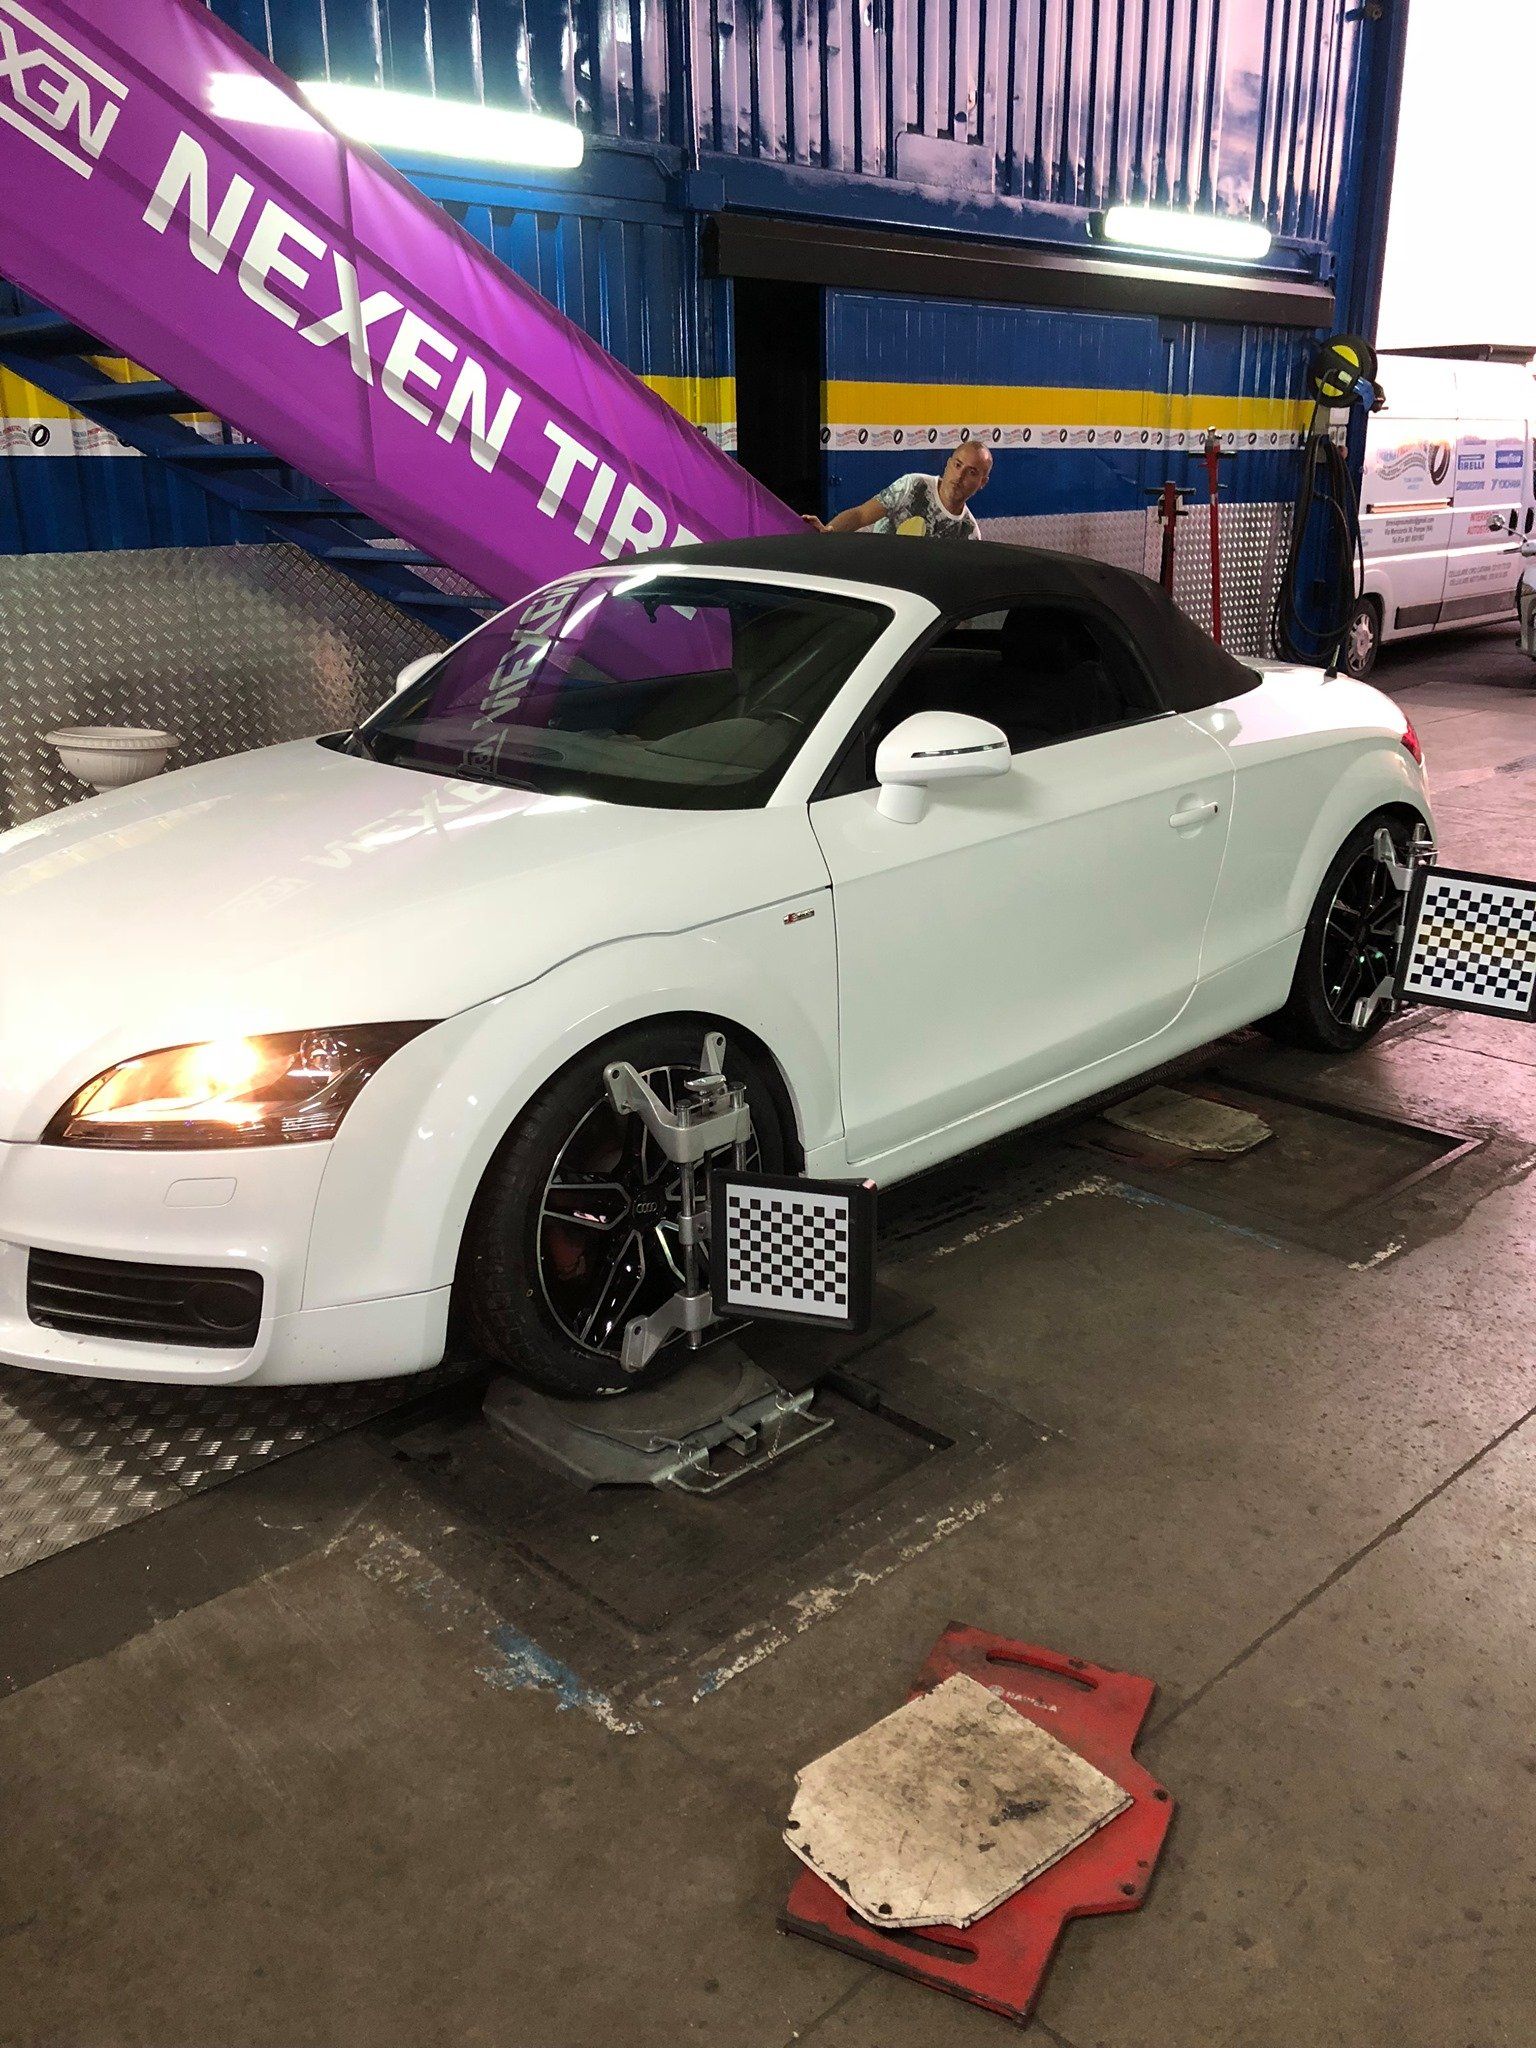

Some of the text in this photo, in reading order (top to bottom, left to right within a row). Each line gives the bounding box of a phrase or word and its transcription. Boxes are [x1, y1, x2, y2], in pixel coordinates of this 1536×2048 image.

[142, 130, 703, 561] NEXEN TIR
[1458, 454, 1485, 470] PIRELLI
